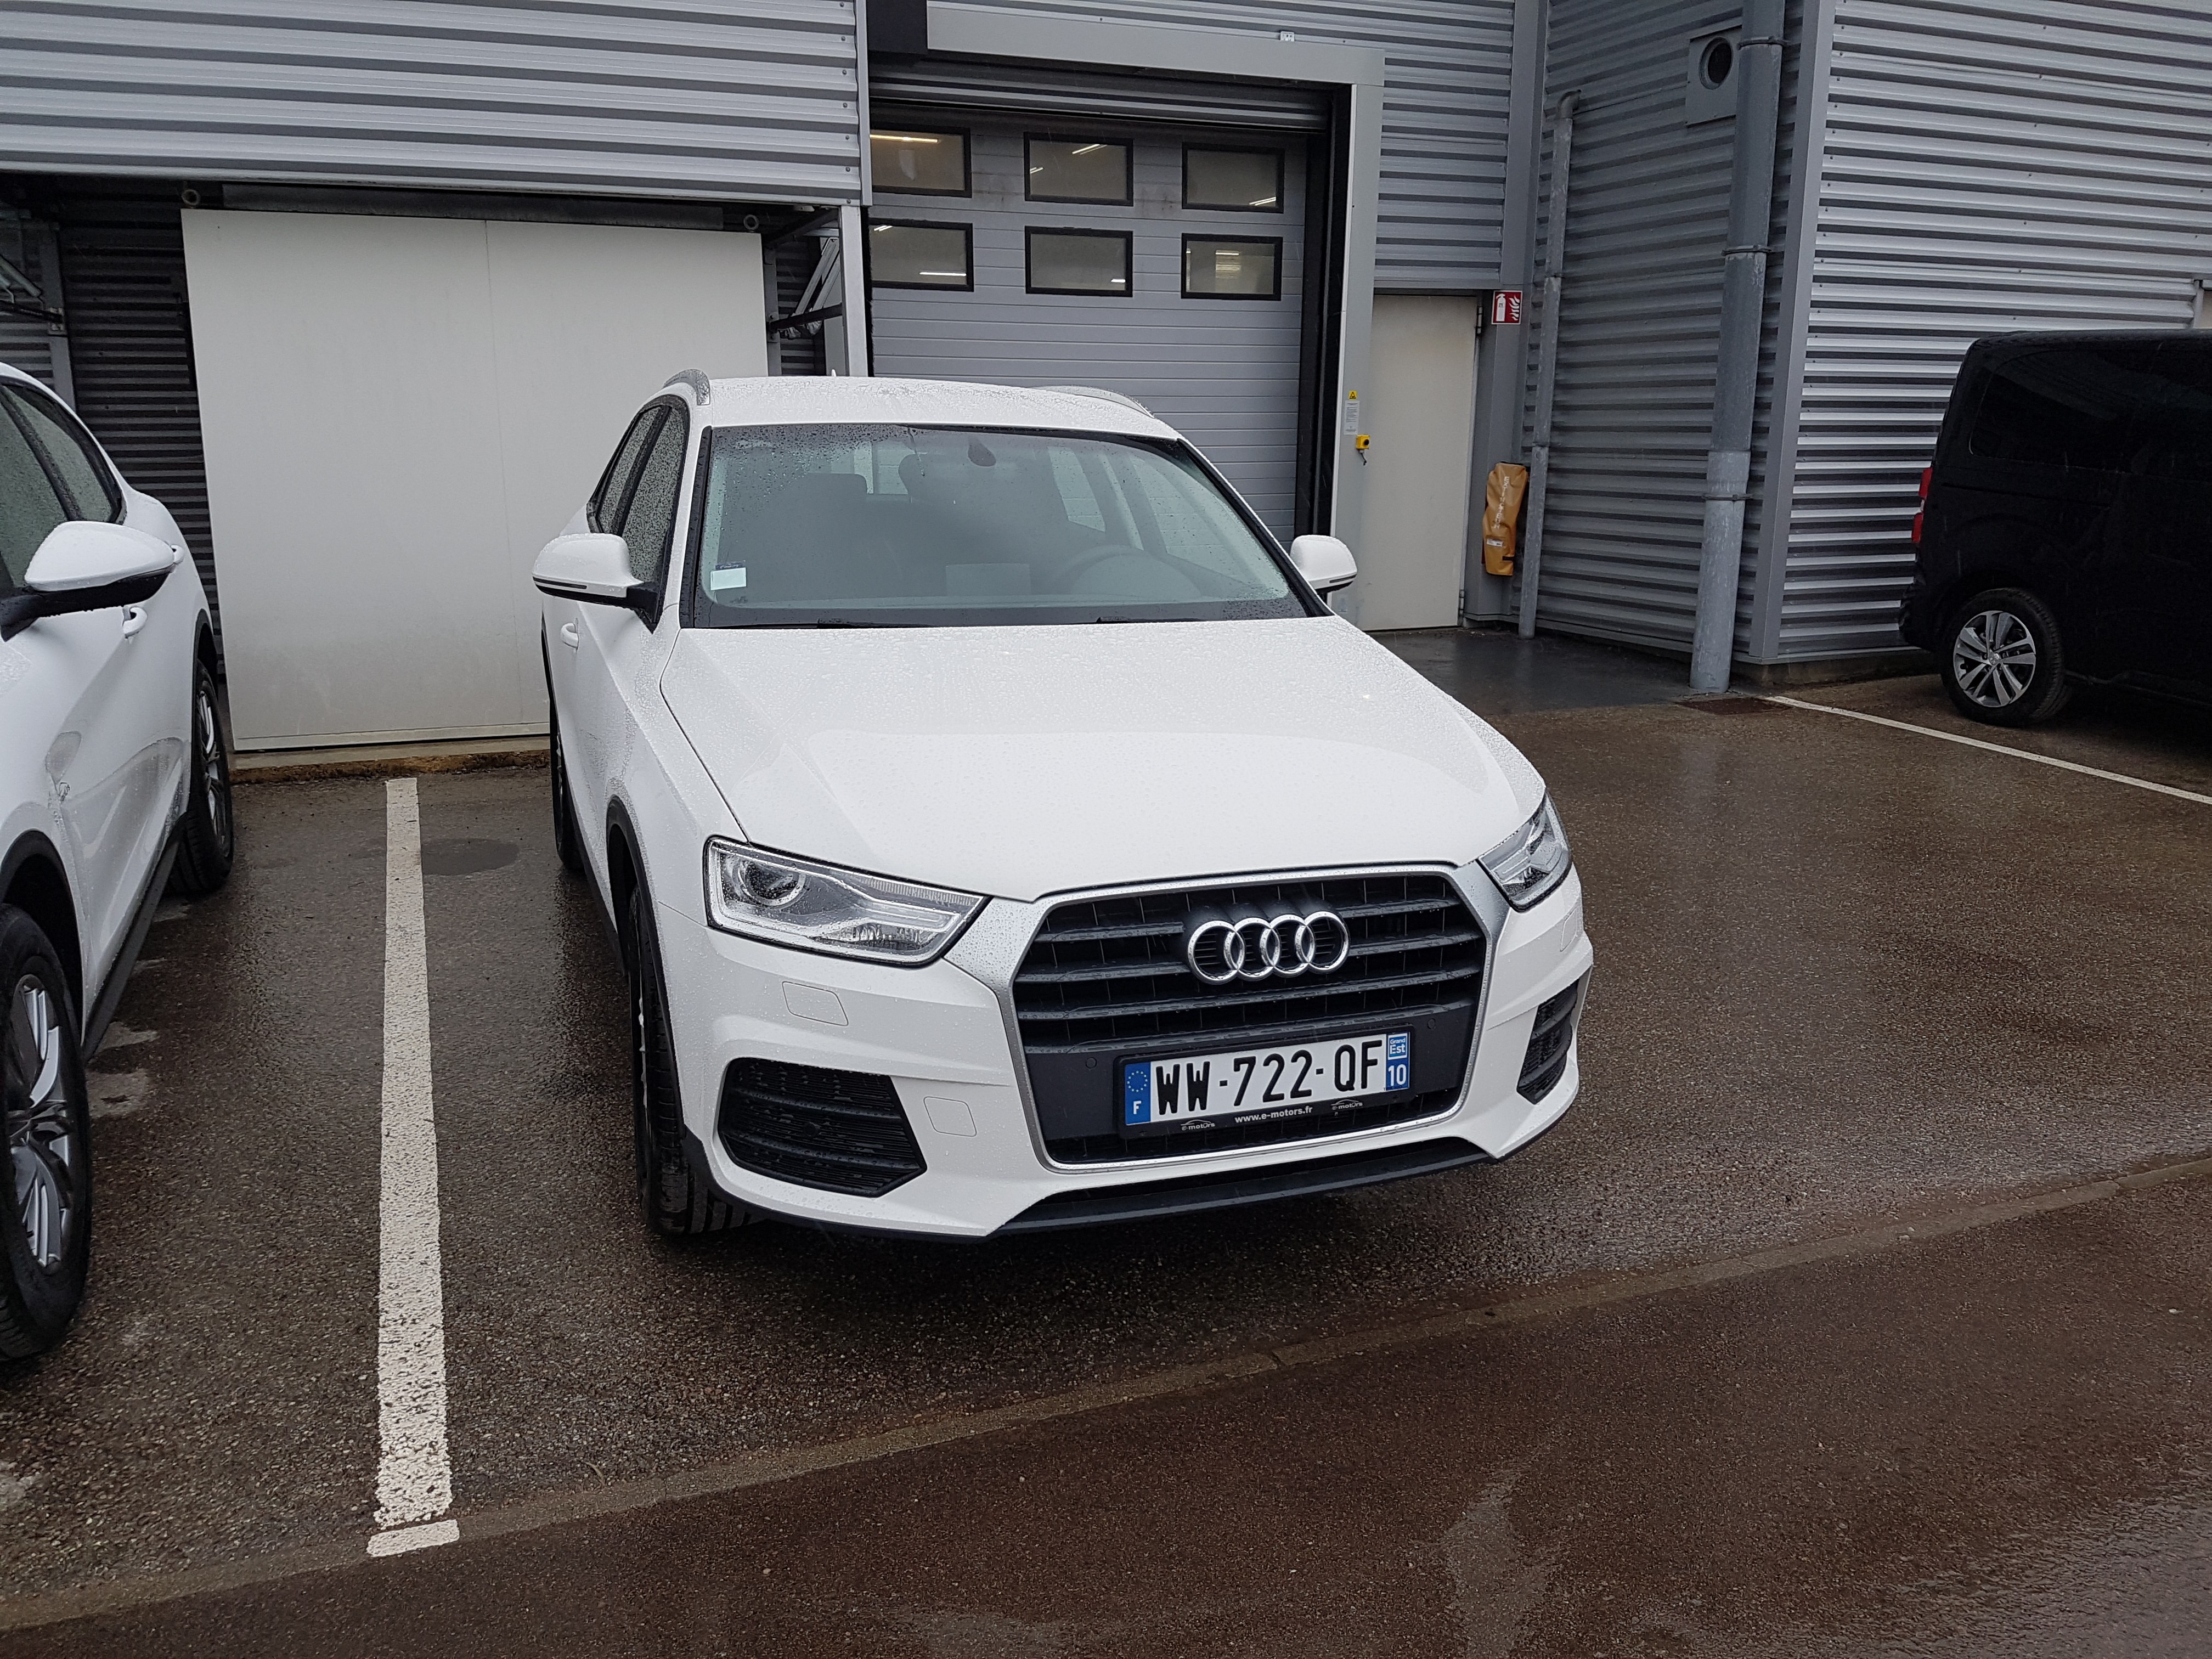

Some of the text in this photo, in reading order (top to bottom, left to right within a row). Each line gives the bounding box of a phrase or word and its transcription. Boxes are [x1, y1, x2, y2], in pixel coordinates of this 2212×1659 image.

[1494, 476, 1510, 529] EXTINCTEUR
[1390, 1043, 1405, 1054] Est
[1155, 1040, 1383, 1115] WW-722-QF
[1388, 1064, 1407, 1086] 10
[1133, 1101, 1142, 1115] F
[1234, 1105, 1313, 1124] www.e-motors.fr
